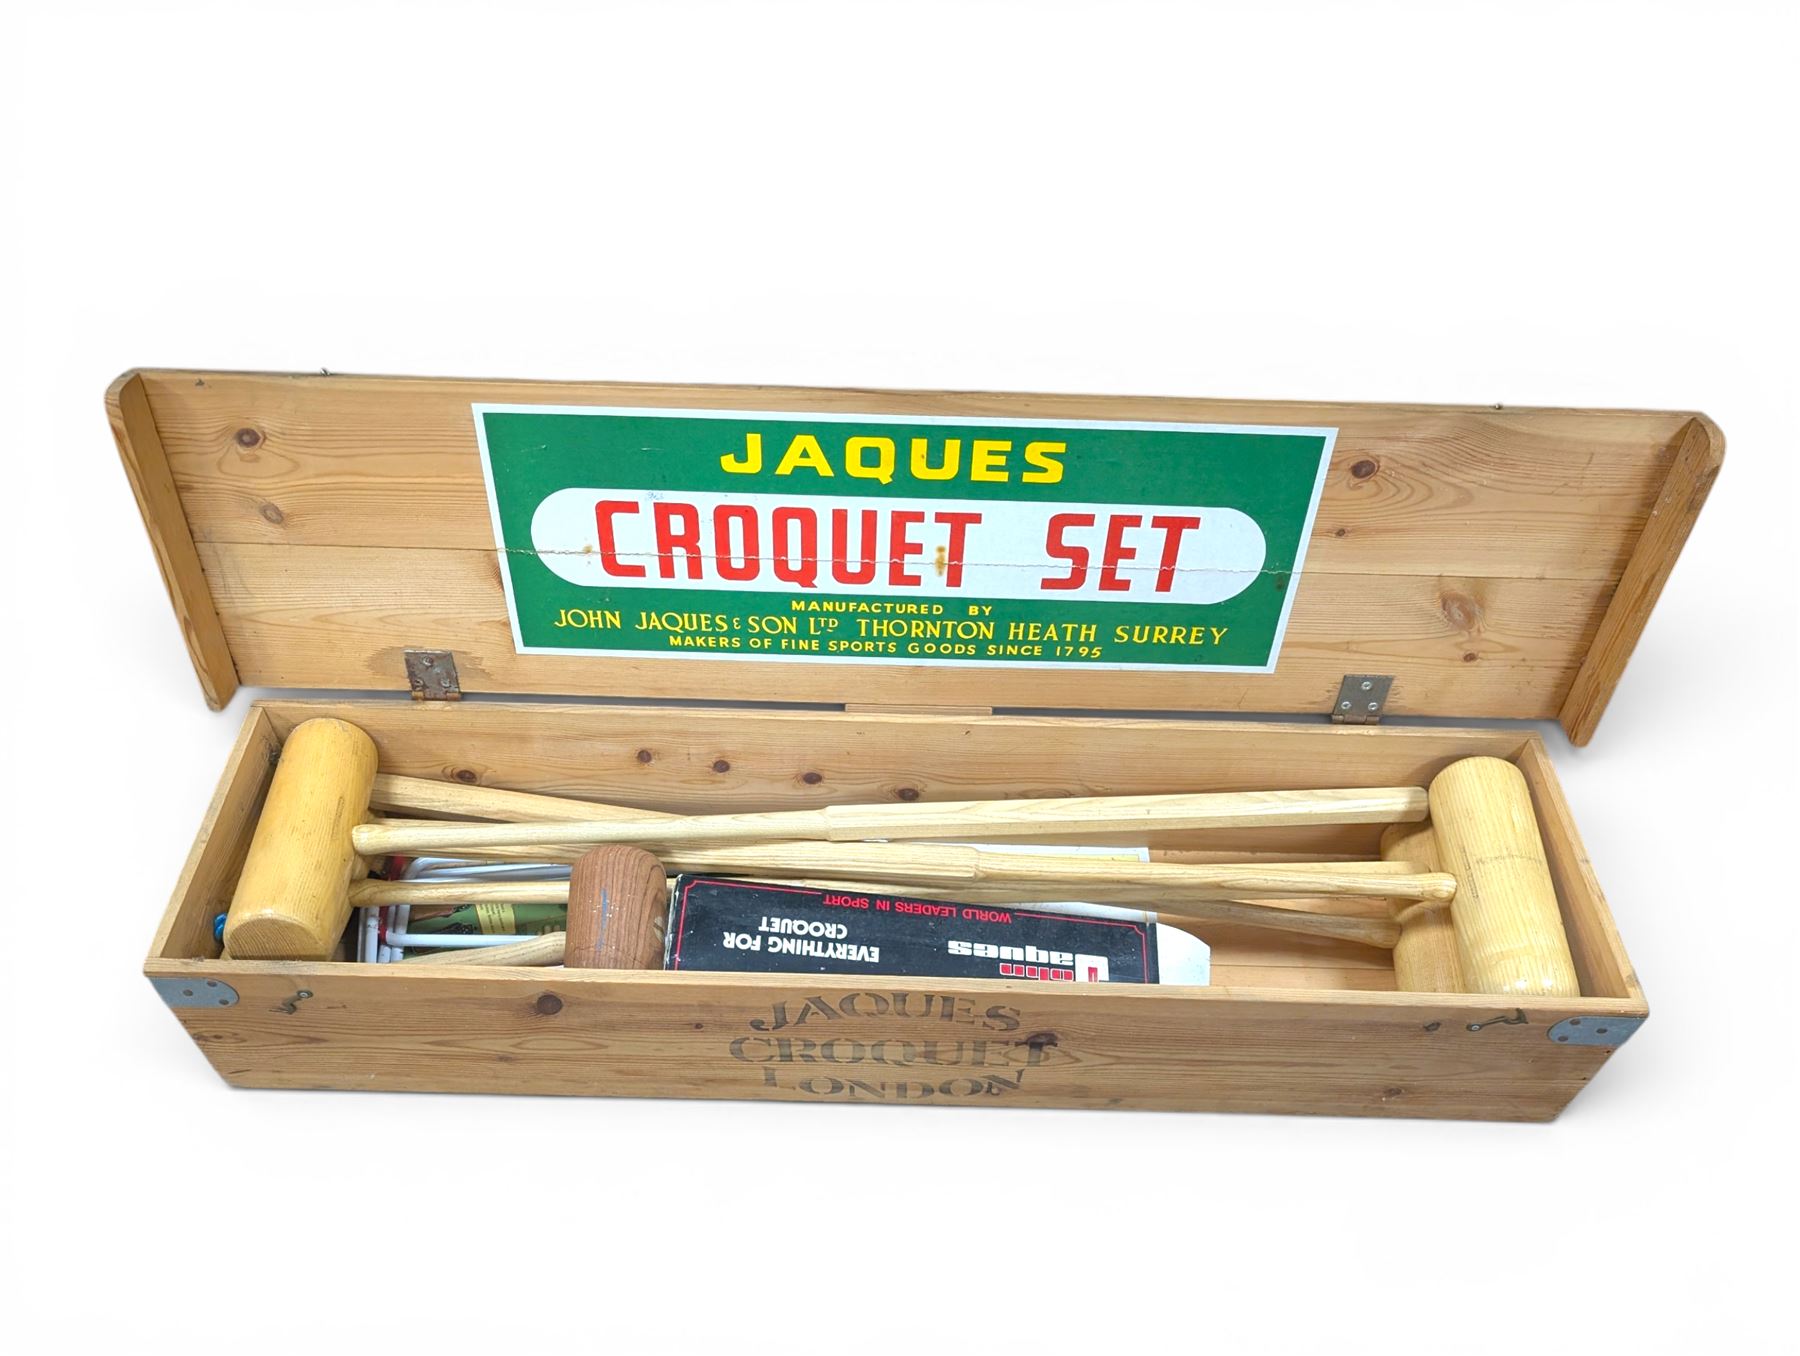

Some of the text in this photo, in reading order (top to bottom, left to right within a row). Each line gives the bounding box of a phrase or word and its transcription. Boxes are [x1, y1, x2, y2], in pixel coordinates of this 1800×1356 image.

[720, 433, 1066, 485] JAQUES
[595, 500, 1201, 592] CROQUET SET
[791, 600, 993, 616] MANUFACTURED BY
[554, 609, 621, 629] JOHN
[635, 612, 728, 633] JAQUES
[747, 616, 797, 634] SON
[856, 619, 996, 640] THORNTON
[1009, 623, 1097, 642] HEATH
[1114, 626, 1228, 645] SURREY
[669, 636, 1103, 659] MAKERS OF FINE SPORTS GOODS SINCE 1795
[823, 895, 1011, 923] WORLD LEADERS IN SPORT
[758, 916, 848, 939] CROQUET
[723, 932, 880, 963] EVERYTHING FOR
[750, 993, 1021, 1031] JAQUES
[729, 1035, 1058, 1067] CROQUET
[762, 1066, 1024, 1099] LONDON
